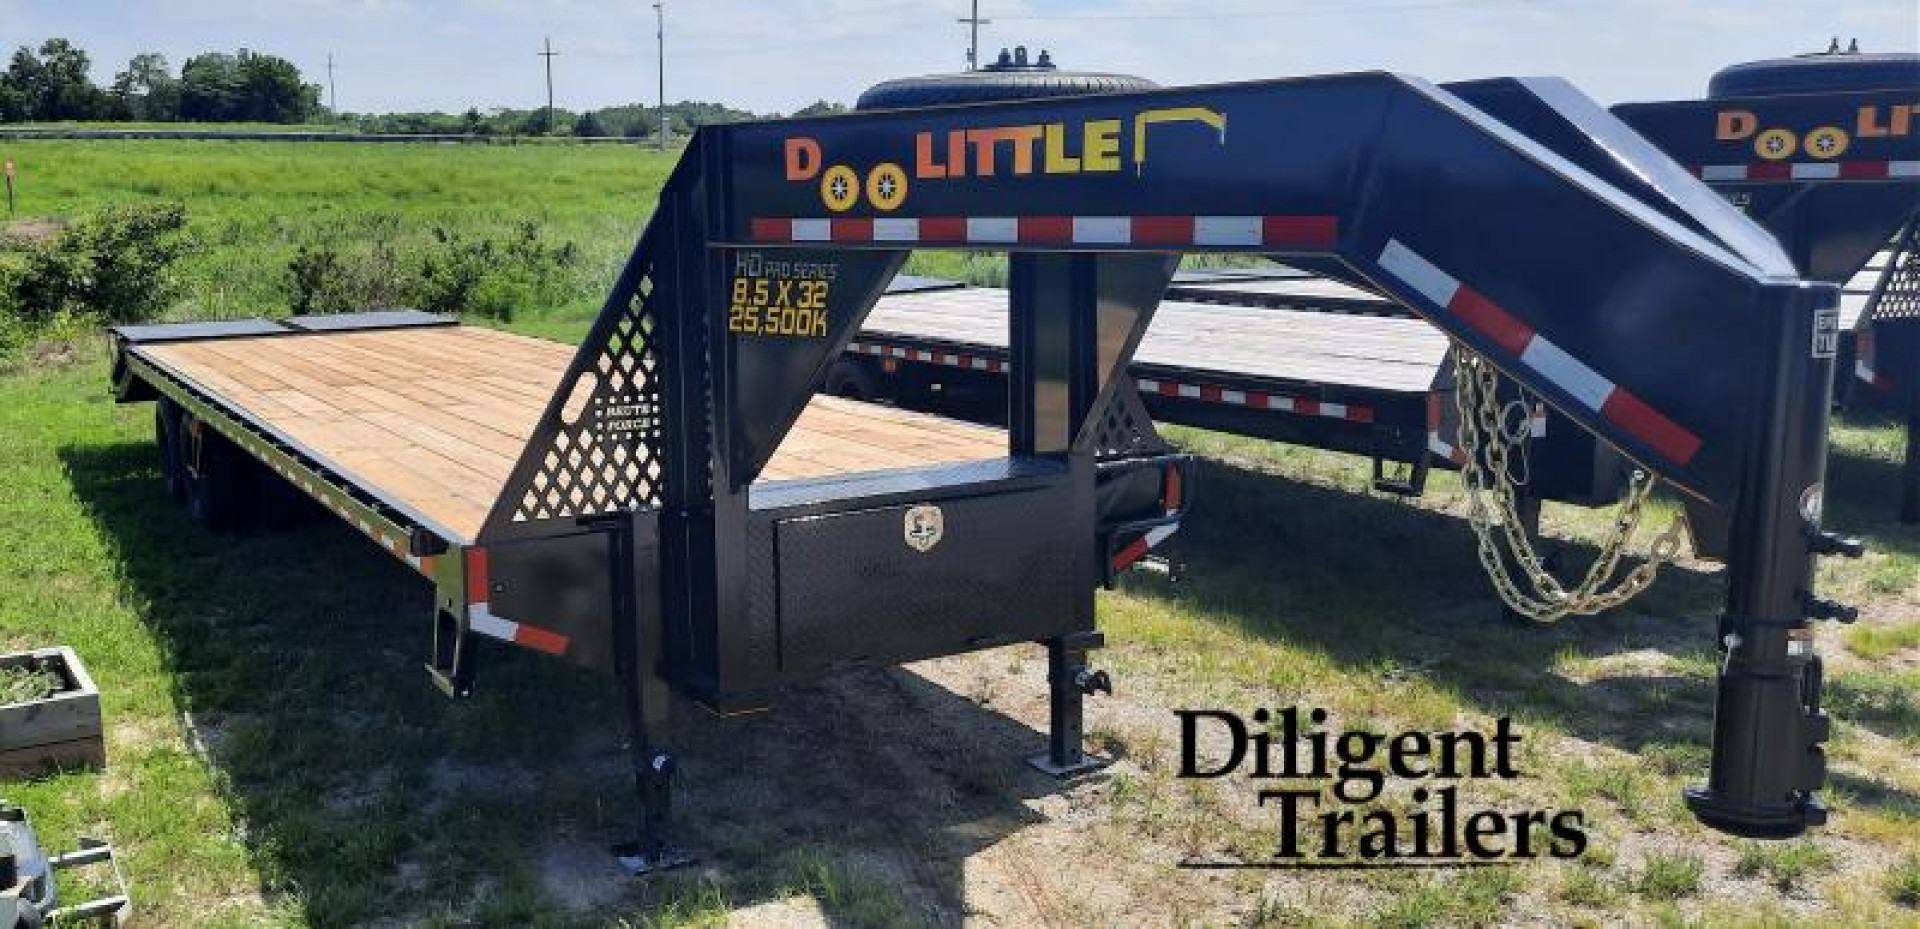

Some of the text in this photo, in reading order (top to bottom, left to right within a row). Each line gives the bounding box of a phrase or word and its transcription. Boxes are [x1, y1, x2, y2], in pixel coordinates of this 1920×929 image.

[733, 278, 828, 308] 8.5 X 32
[729, 305, 828, 337] 25,500K
